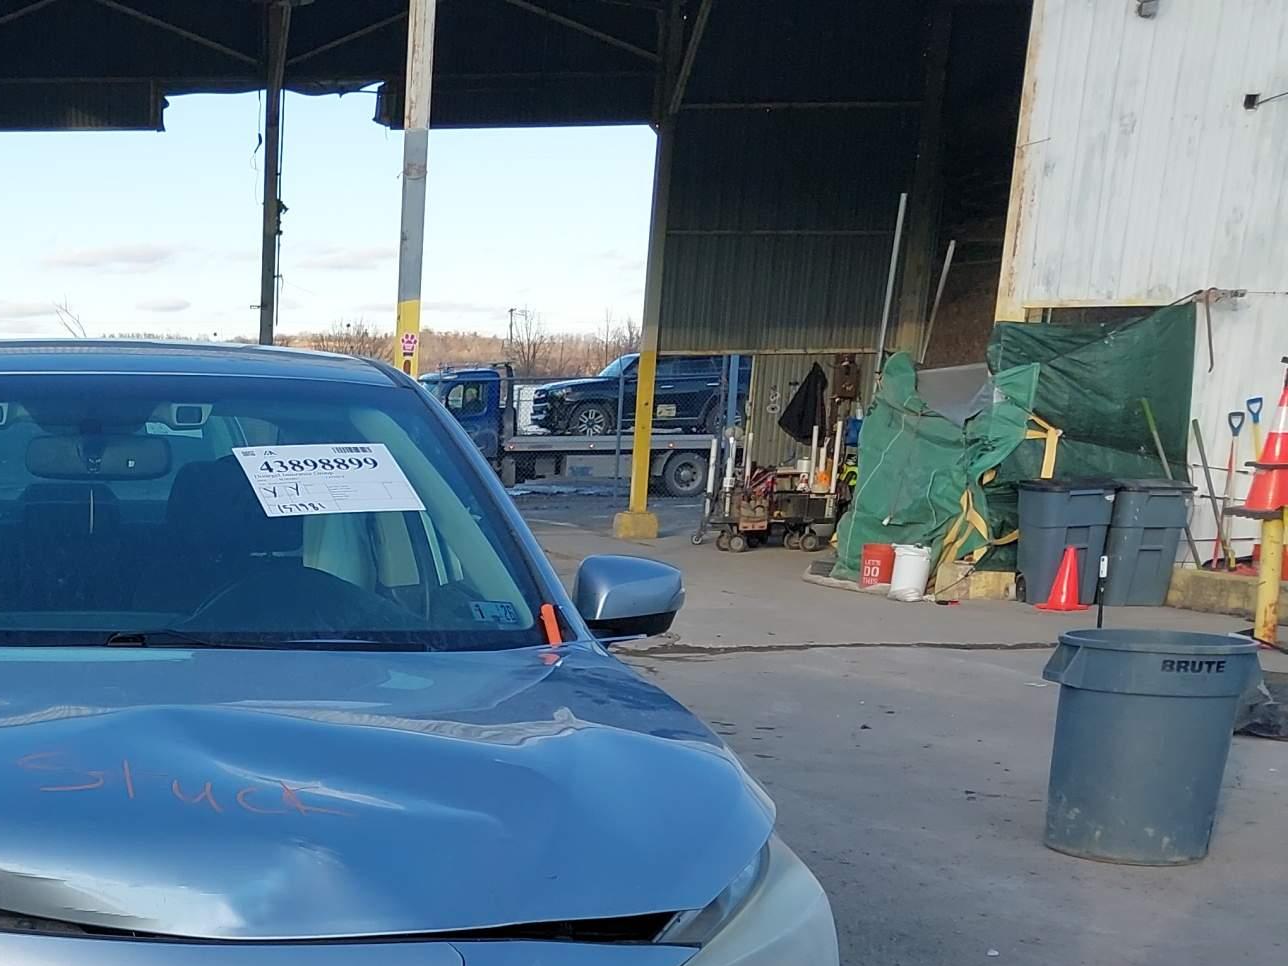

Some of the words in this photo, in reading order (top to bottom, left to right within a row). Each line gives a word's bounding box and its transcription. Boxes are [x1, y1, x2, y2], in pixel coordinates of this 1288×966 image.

[259, 456, 379, 474] 43898899
[863, 566, 880, 577] DO
[1161, 659, 1227, 673] BRUTE
